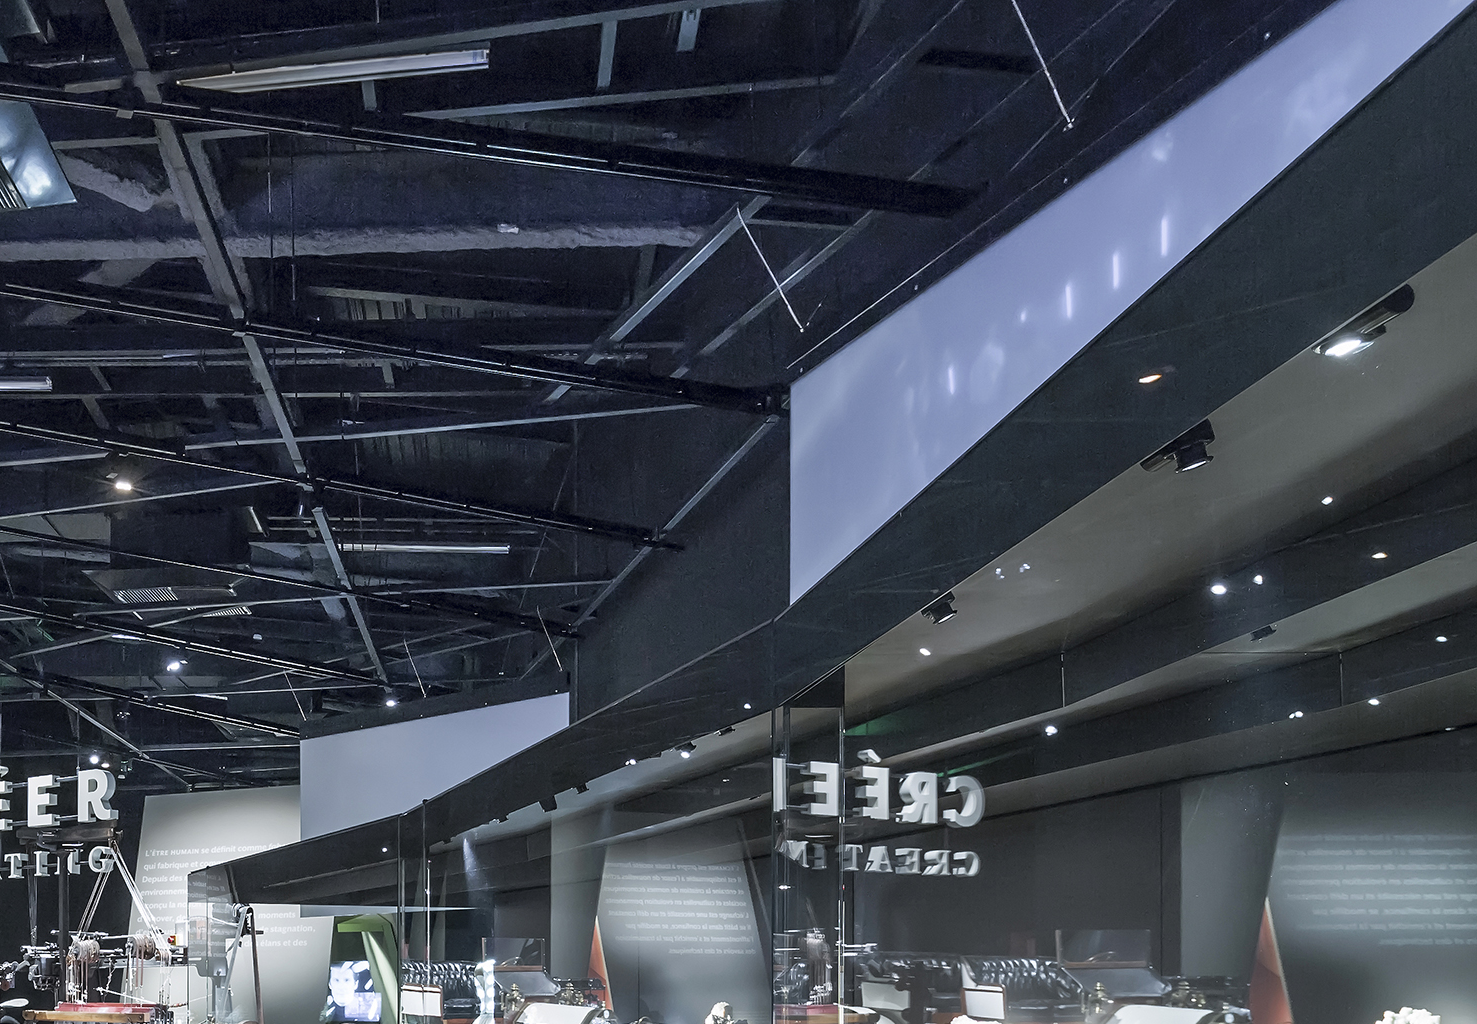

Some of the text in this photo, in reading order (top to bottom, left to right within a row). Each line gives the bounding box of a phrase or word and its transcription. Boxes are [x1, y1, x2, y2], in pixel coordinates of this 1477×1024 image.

[170, 848, 200, 856] HUMAIN
[210, 844, 236, 854] définit
[237, 844, 267, 852] comme
[143, 862, 156, 871] qui
[157, 861, 189, 870] fabrique
[141, 874, 183, 884] Depuis des
[258, 911, 296, 919] moments
[270, 924, 316, 934] stagnation,
[260, 939, 281, 947] élans
[282, 939, 291, 947] et
[292, 938, 308, 947] des
